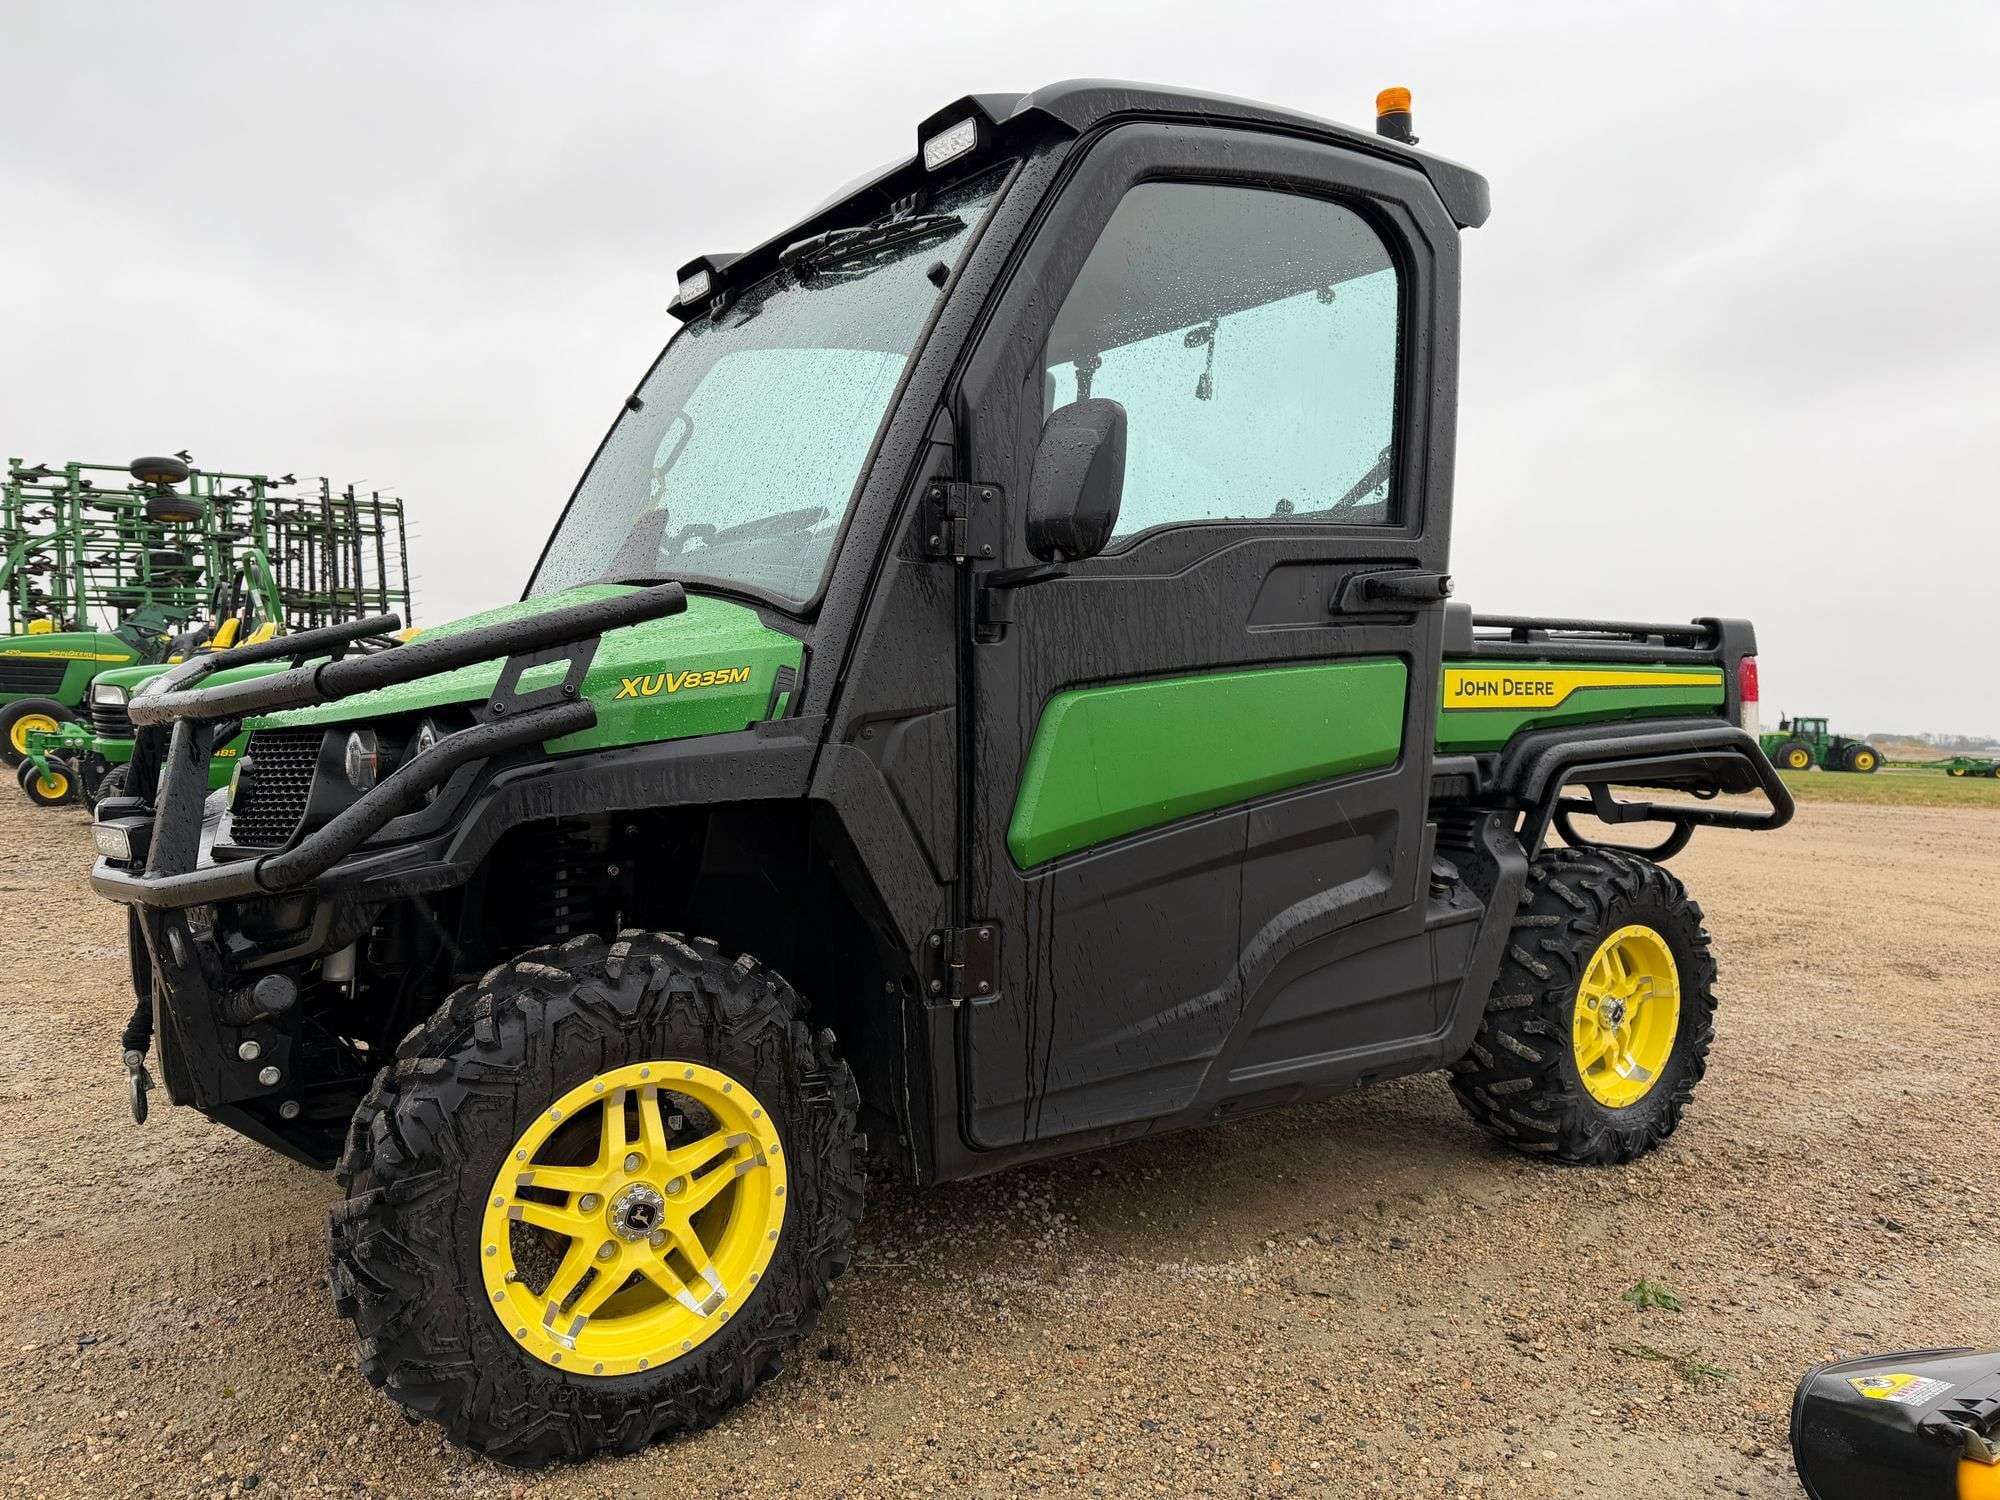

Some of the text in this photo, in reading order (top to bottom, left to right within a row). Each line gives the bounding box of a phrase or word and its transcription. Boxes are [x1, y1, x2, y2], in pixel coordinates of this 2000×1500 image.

[613, 667, 750, 699] XUV835M
[1455, 678, 1555, 696] JOHN DEERE
